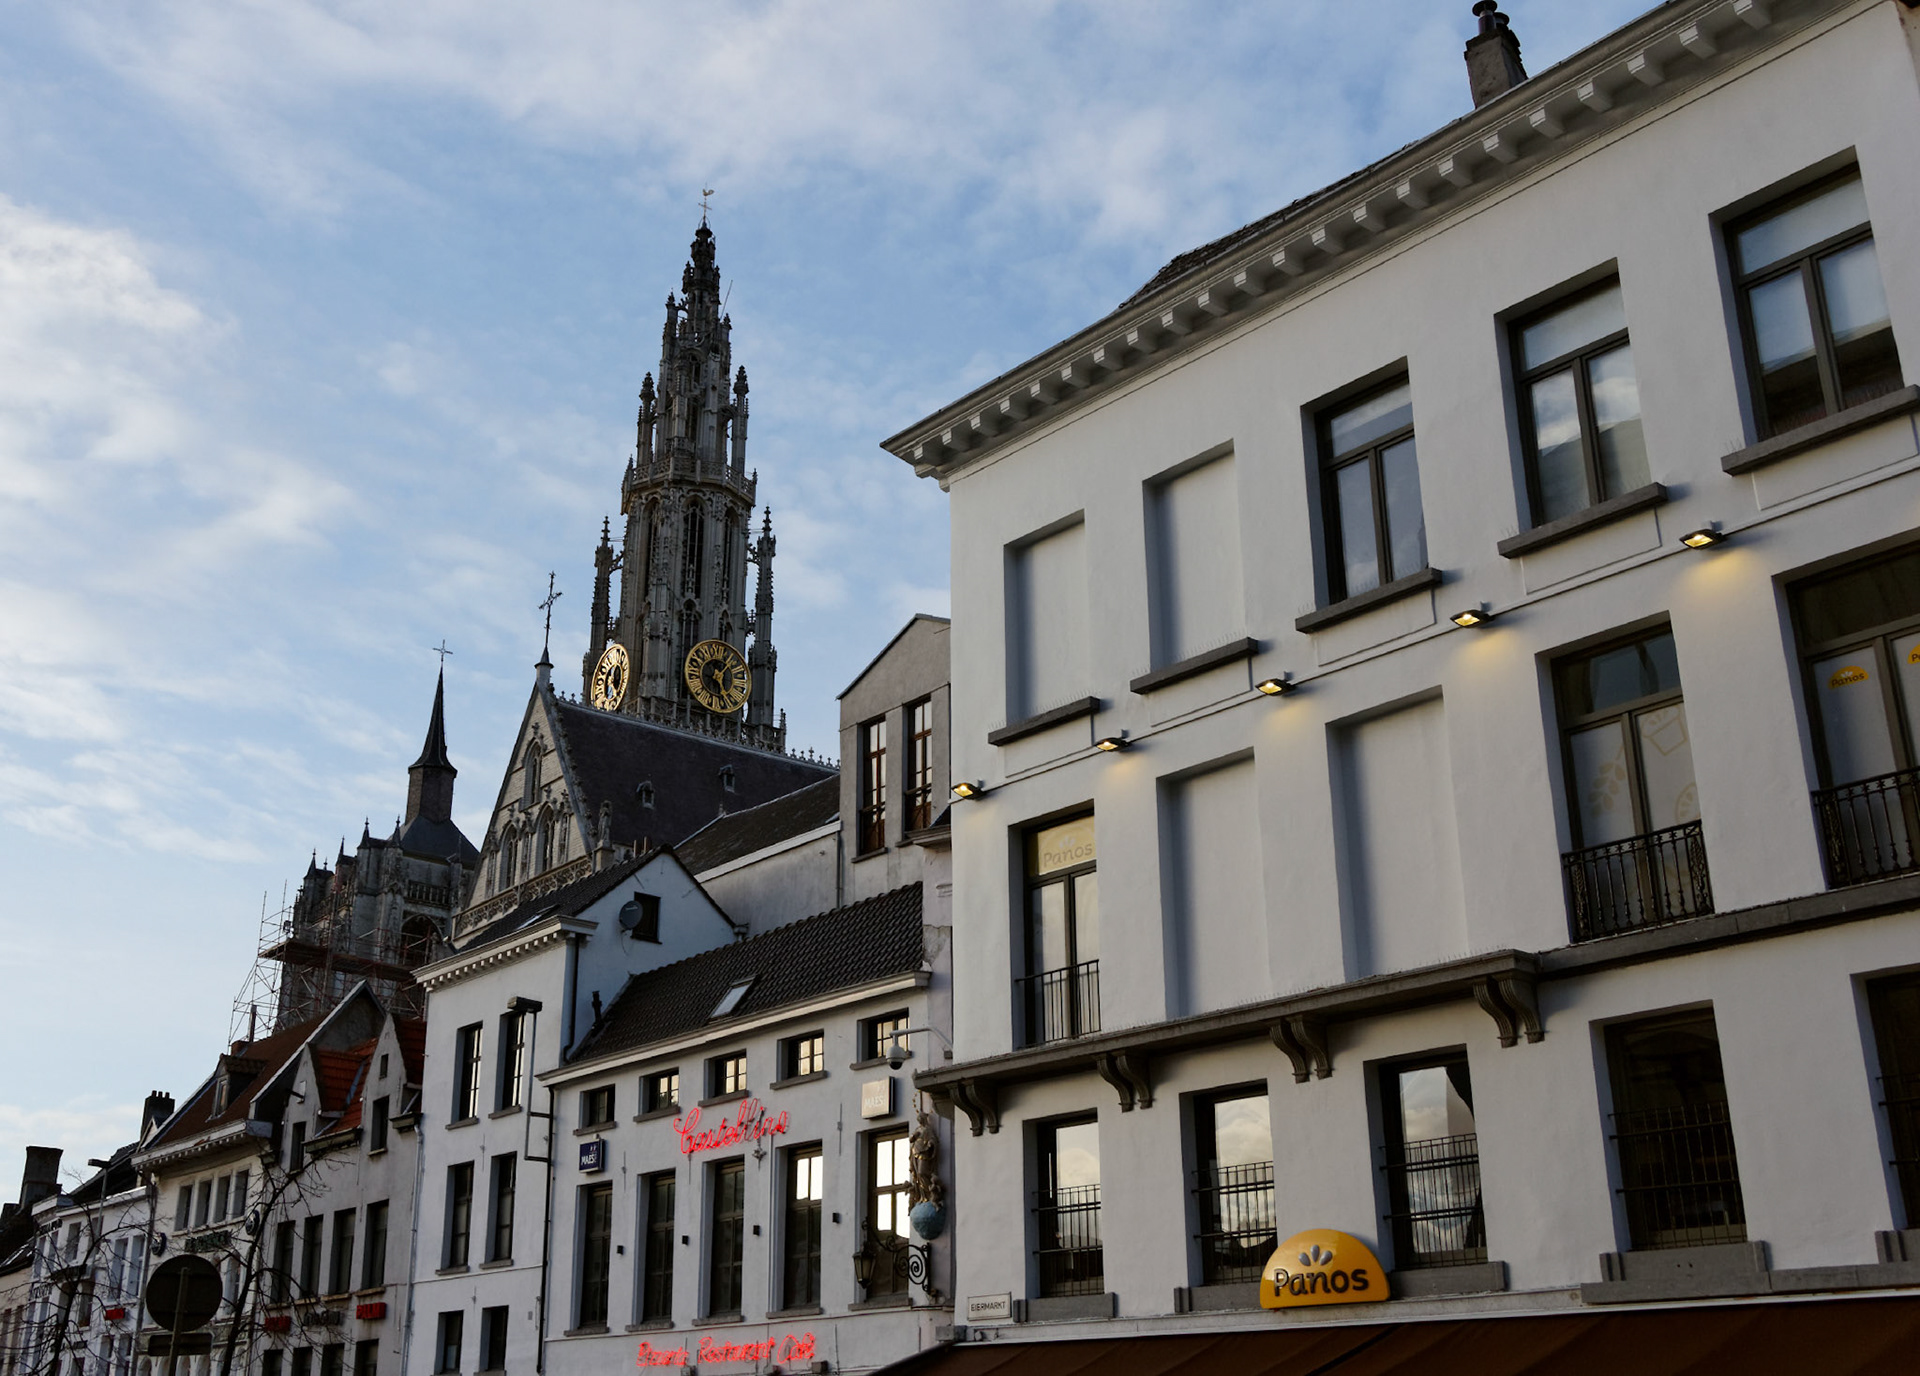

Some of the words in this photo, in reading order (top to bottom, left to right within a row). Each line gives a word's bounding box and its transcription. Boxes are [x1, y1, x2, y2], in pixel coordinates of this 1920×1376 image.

[1831, 673, 1865, 687] Panos
[1043, 843, 1093, 868] Panos
[673, 1097, 787, 1154] Castellino
[581, 1154, 595, 1166] MAES
[1274, 1268, 1370, 1297] Panos
[970, 1301, 1006, 1312] EIERMARKT
[698, 1336, 776, 1364] Restaurant
